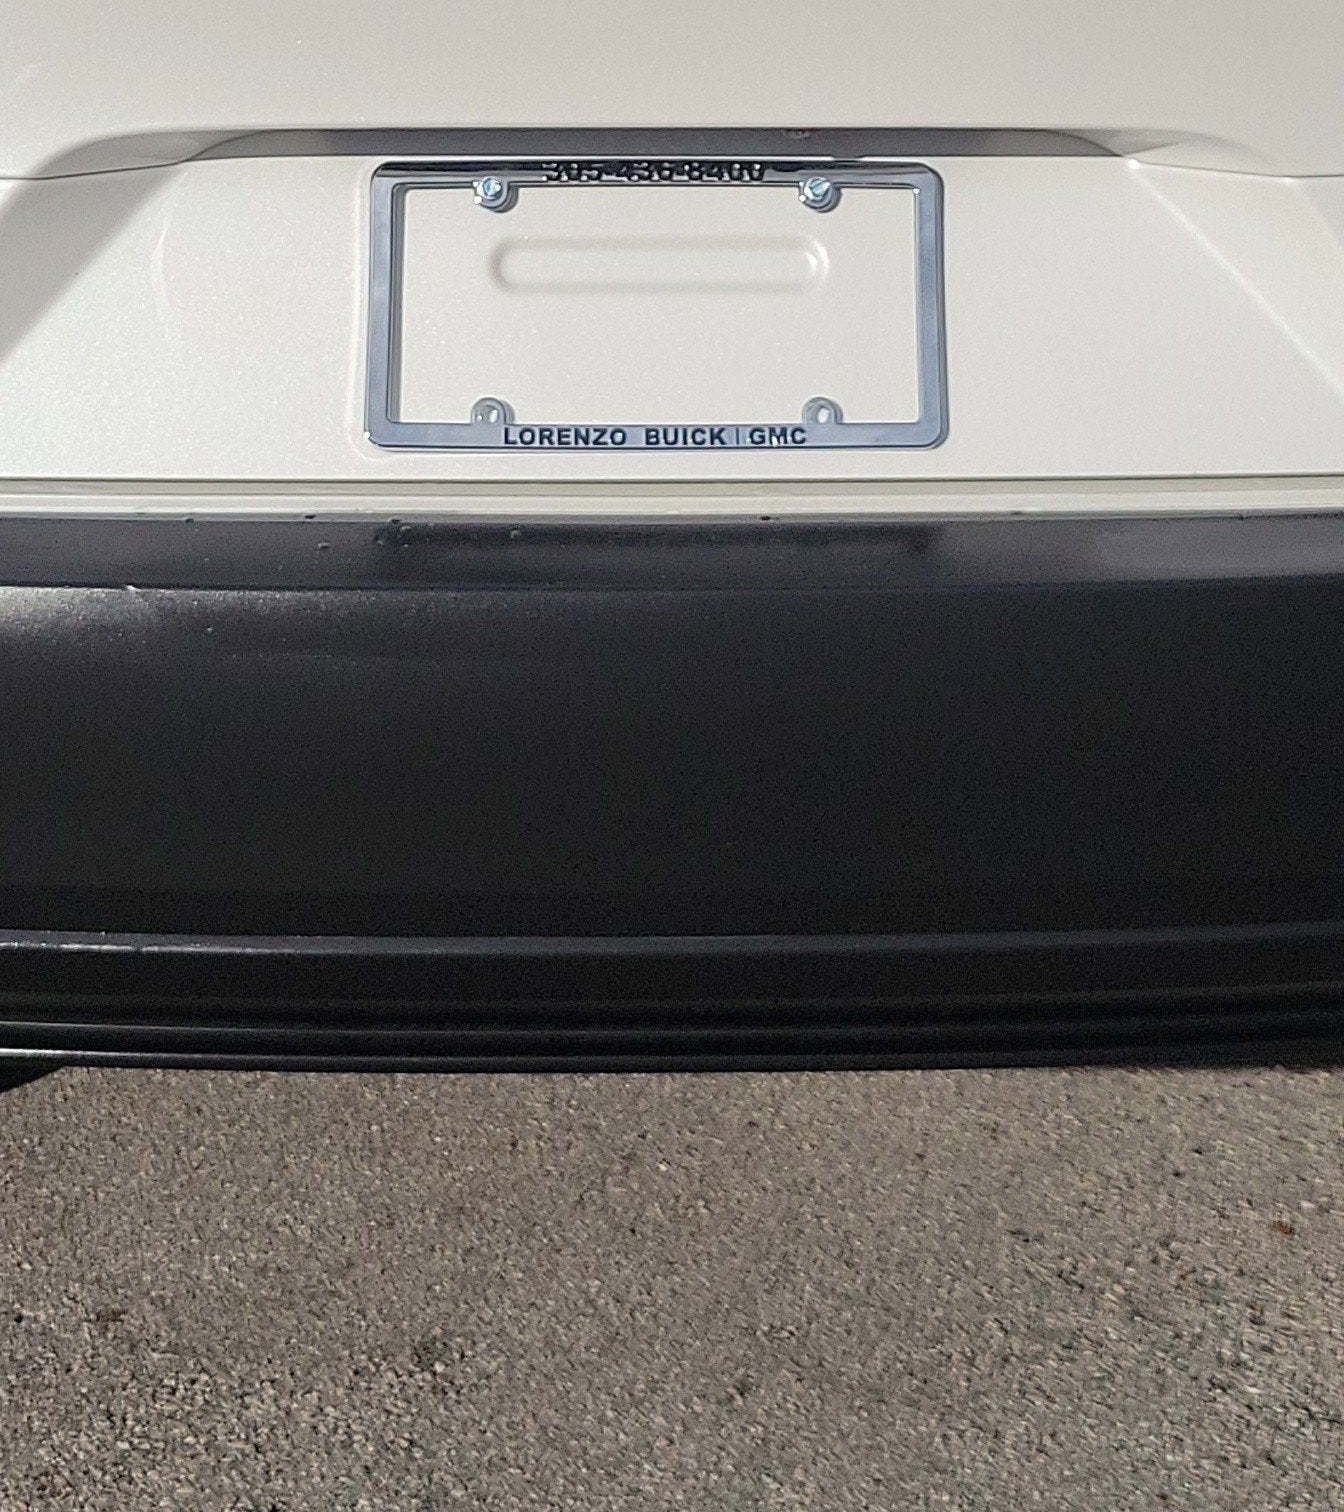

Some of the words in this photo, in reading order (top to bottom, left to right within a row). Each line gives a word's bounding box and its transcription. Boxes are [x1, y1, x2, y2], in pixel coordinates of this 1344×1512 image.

[503, 426, 627, 446] LORENZO
[644, 426, 727, 446] BUICK
[748, 426, 807, 446] GMC
